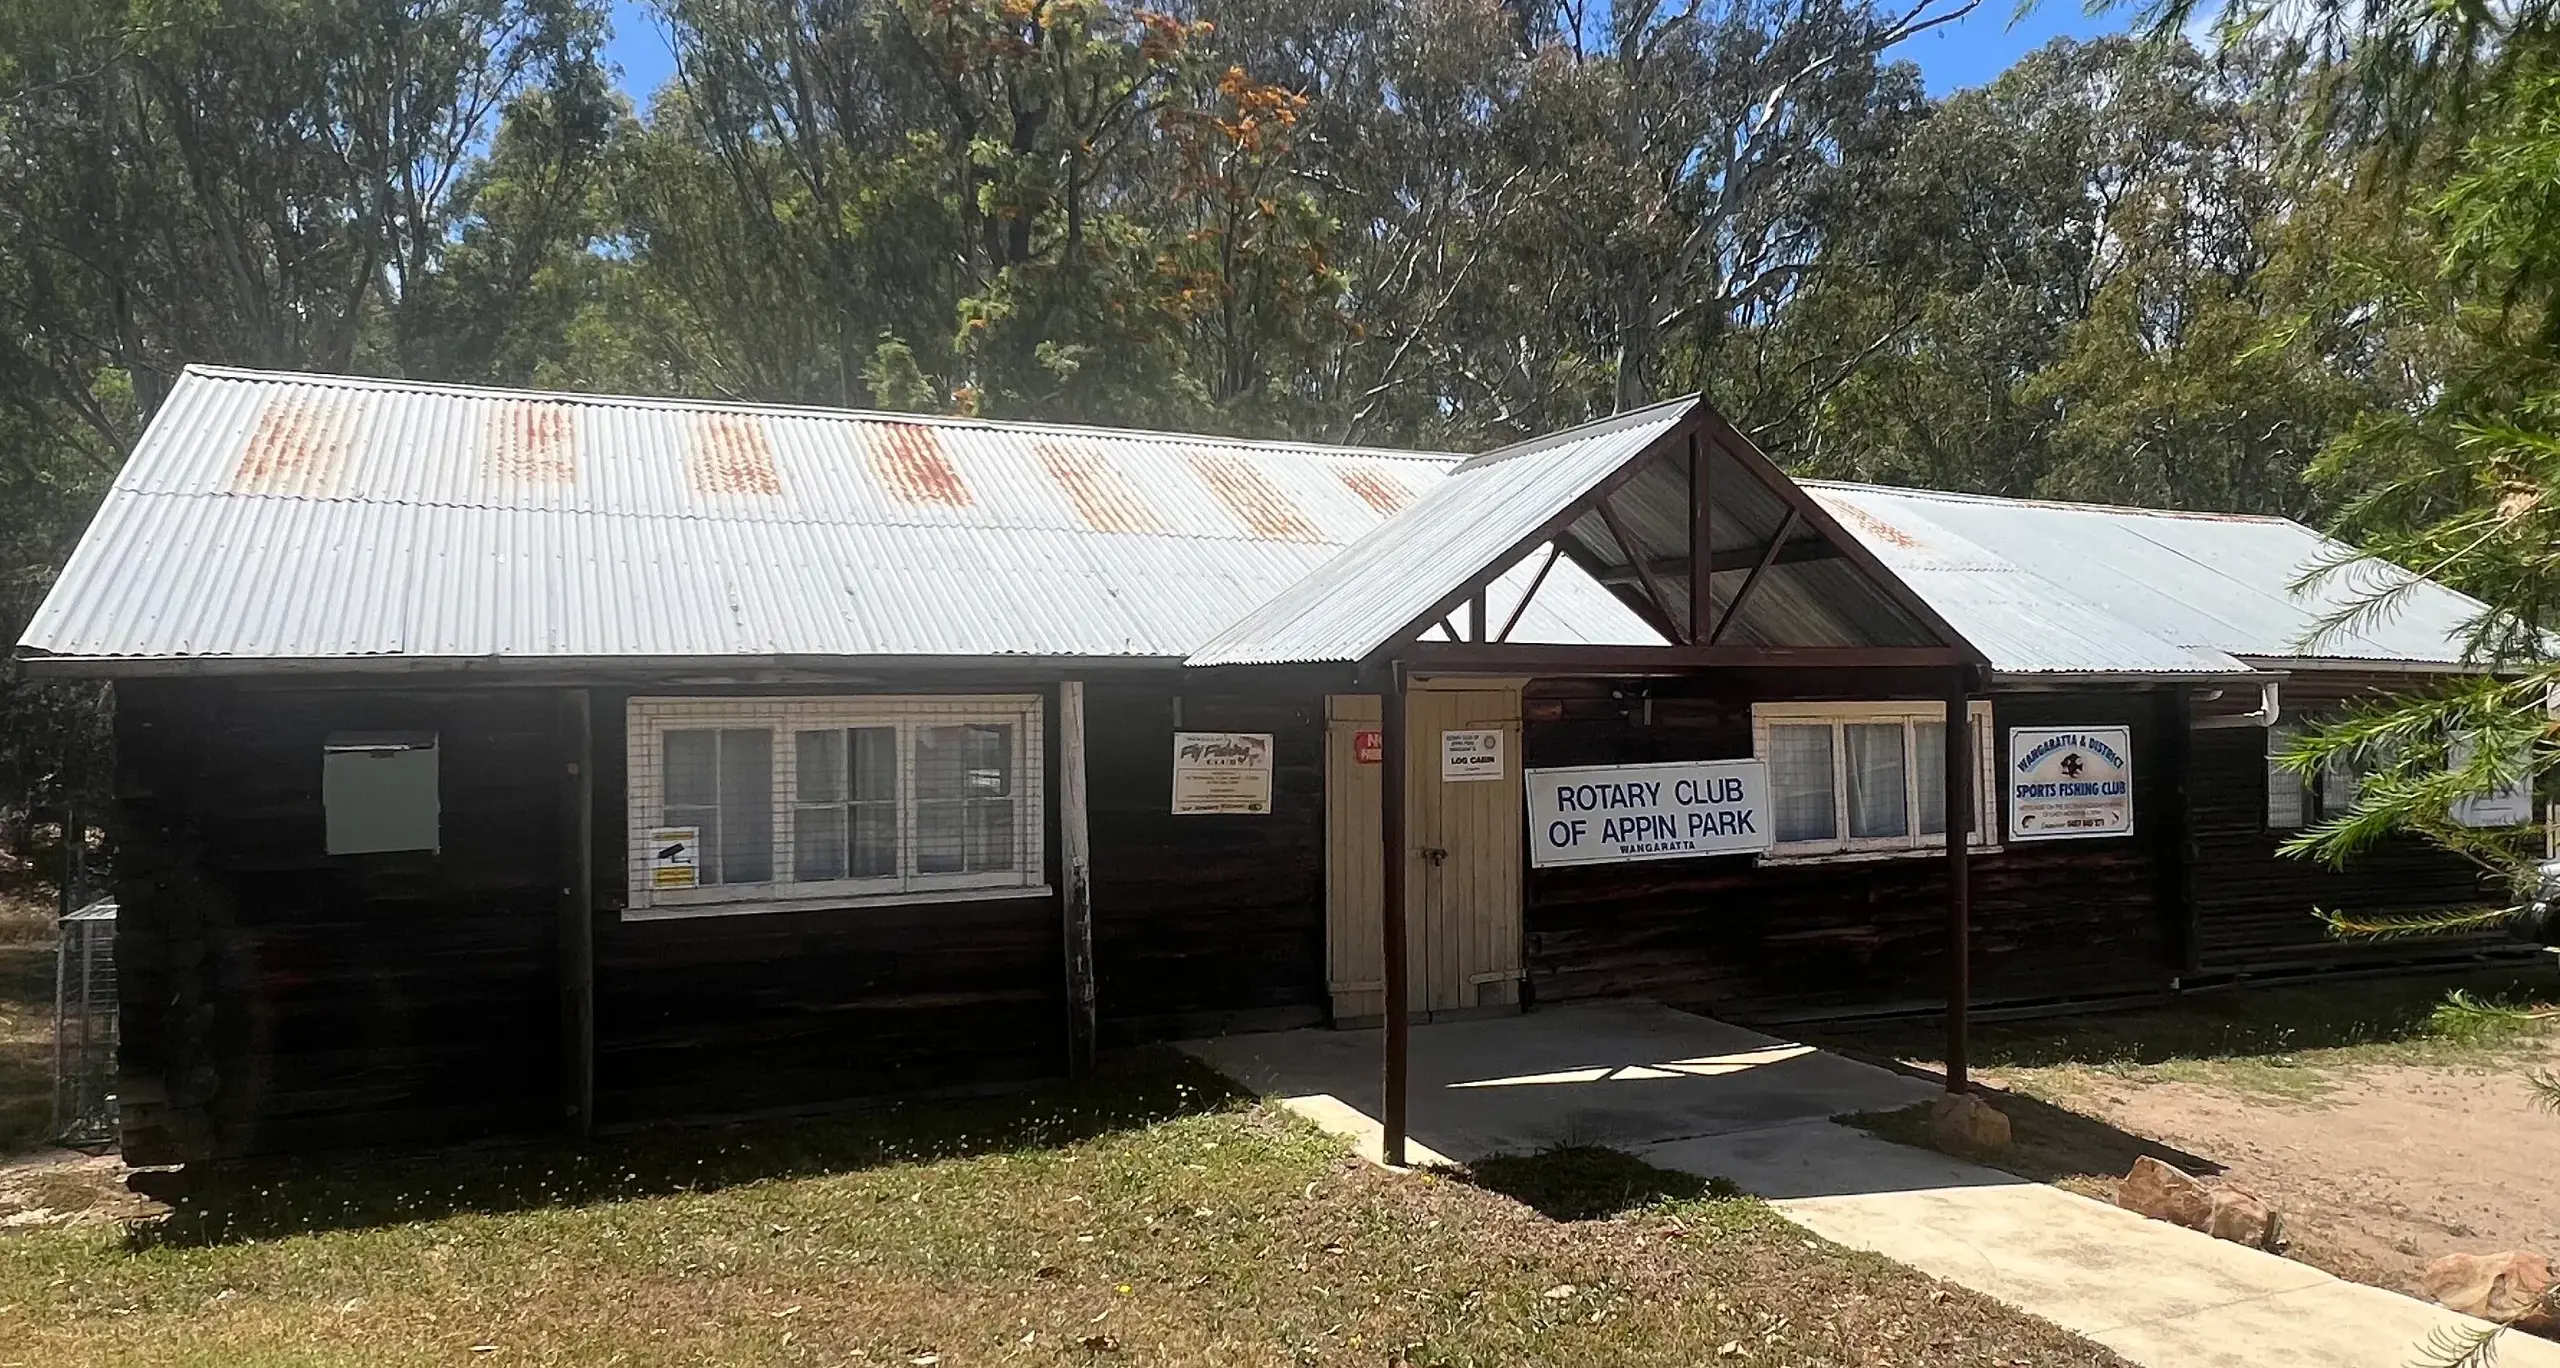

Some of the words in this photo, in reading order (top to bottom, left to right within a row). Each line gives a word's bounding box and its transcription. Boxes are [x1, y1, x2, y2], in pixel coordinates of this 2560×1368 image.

[2017, 735, 2077, 772] WANGARATTA
[2079, 735, 2086, 748] &
[2088, 737, 2124, 769] DISTRICT
[1557, 782, 1661, 812] ROTARY
[1675, 778, 1744, 806] CLUB
[2016, 783, 2057, 798] SPORTS
[2060, 782, 2099, 796] FISHING
[2101, 781, 2126, 795] CLUB
[1548, 820, 1587, 848] OF
[1601, 814, 1677, 843] APPIN
[1688, 810, 1756, 837] PARK
[1620, 840, 1695, 854] WANGARATTA
